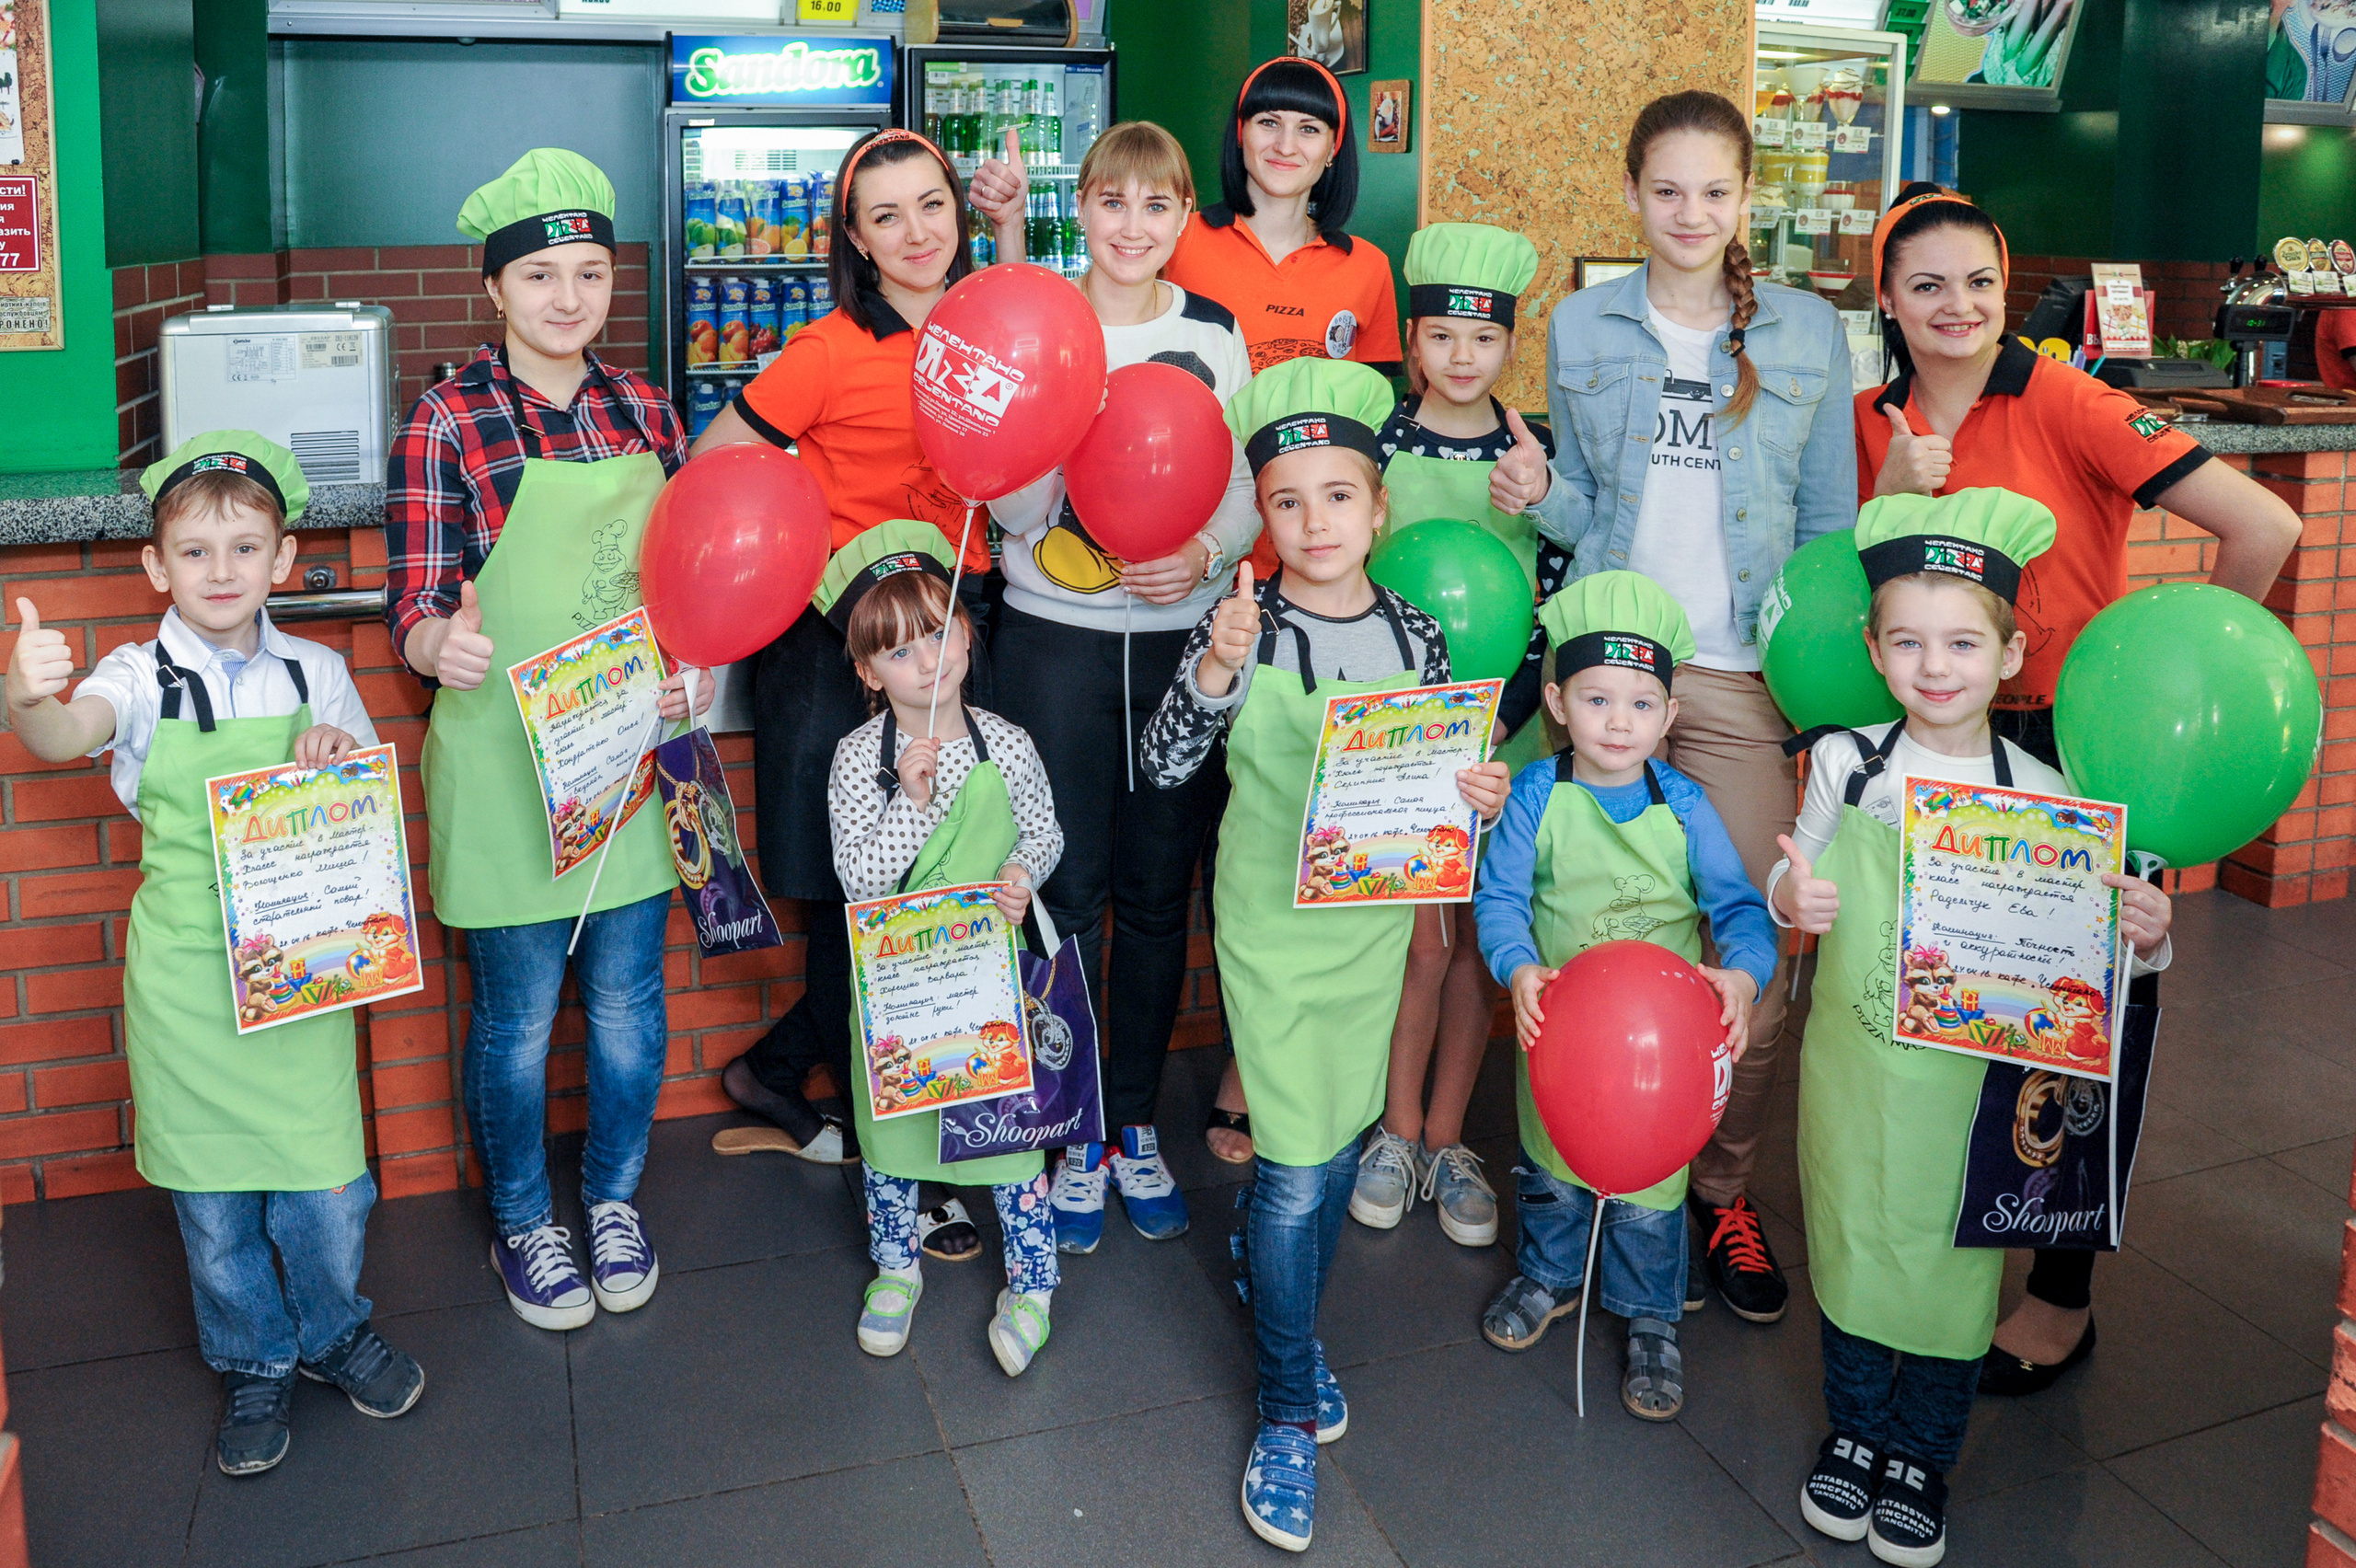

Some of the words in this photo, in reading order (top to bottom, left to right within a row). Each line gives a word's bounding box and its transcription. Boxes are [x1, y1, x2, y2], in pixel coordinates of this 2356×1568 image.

[686, 42, 881, 98] Sandora
[0, 184, 26, 196] сти!
[0, 252, 20, 267] 77
[1265, 305, 1304, 317] PIZZA
[0, 318, 48, 329] РОНЕНО!
[927, 320, 1026, 382] ЧЕЛЕНТАНО
[913, 371, 1000, 427] CELENTANO
[1651, 454, 1680, 467] UTH
[1994, 694, 2047, 705] EOPLE
[589, 717, 595, 725] в
[1356, 753, 1405, 768] участие
[260, 840, 306, 860] участие
[318, 834, 324, 843] в
[1951, 861, 2002, 877] участие
[2016, 870, 2024, 879] в
[2034, 876, 2085, 894] мастер
[698, 908, 763, 949] Shoopart
[892, 953, 931, 972] участие
[965, 1107, 1082, 1149] Shoopart
[1982, 1193, 2106, 1244] Shoopart
